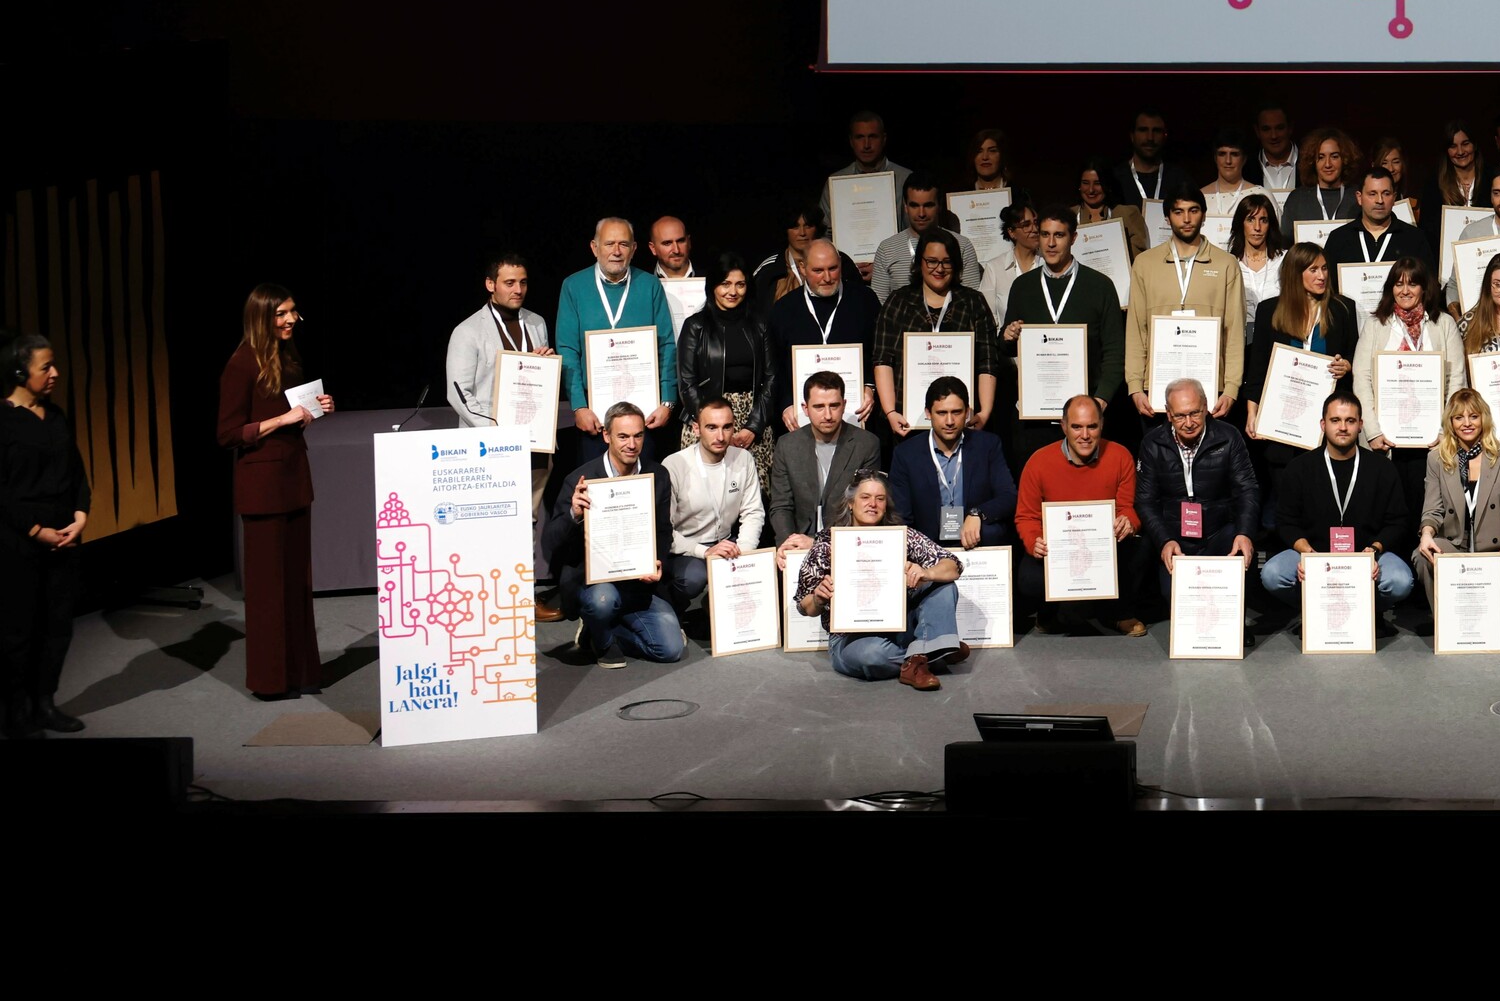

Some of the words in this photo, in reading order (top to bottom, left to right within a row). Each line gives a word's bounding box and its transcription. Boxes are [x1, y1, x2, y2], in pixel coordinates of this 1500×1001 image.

[432, 467, 486, 476] EUSKARAREN
[432, 475, 492, 484] ERABILERAREN
[396, 662, 437, 686] Jalgi
[409, 679, 451, 698] hadi
[389, 692, 458, 713] LANera!
